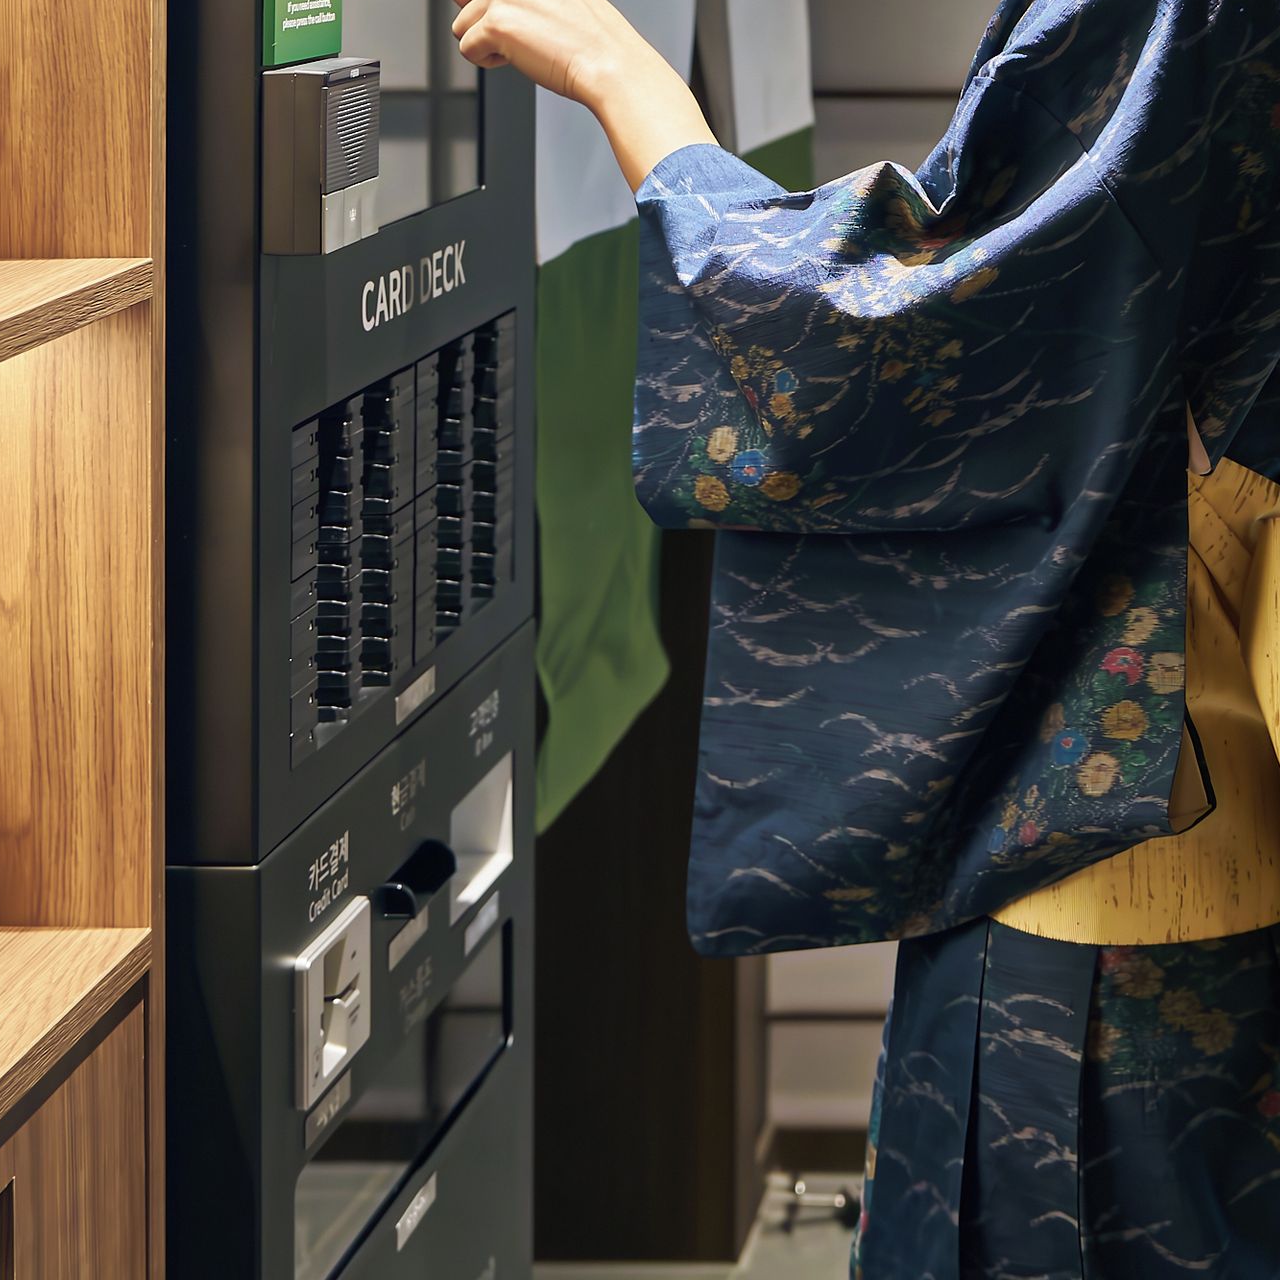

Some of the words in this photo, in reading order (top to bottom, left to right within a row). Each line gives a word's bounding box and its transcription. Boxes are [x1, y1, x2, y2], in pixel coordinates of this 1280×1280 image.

[282, 18, 296, 31] please
[296, 17, 307, 29] press
[322, 12, 336, 23] button
[361, 264, 415, 332] CARD
[420, 240, 466, 305] DECK
[308, 830, 349, 891] 카드결제
[309, 887, 331, 922] Credit
[332, 867, 349, 899] Card
